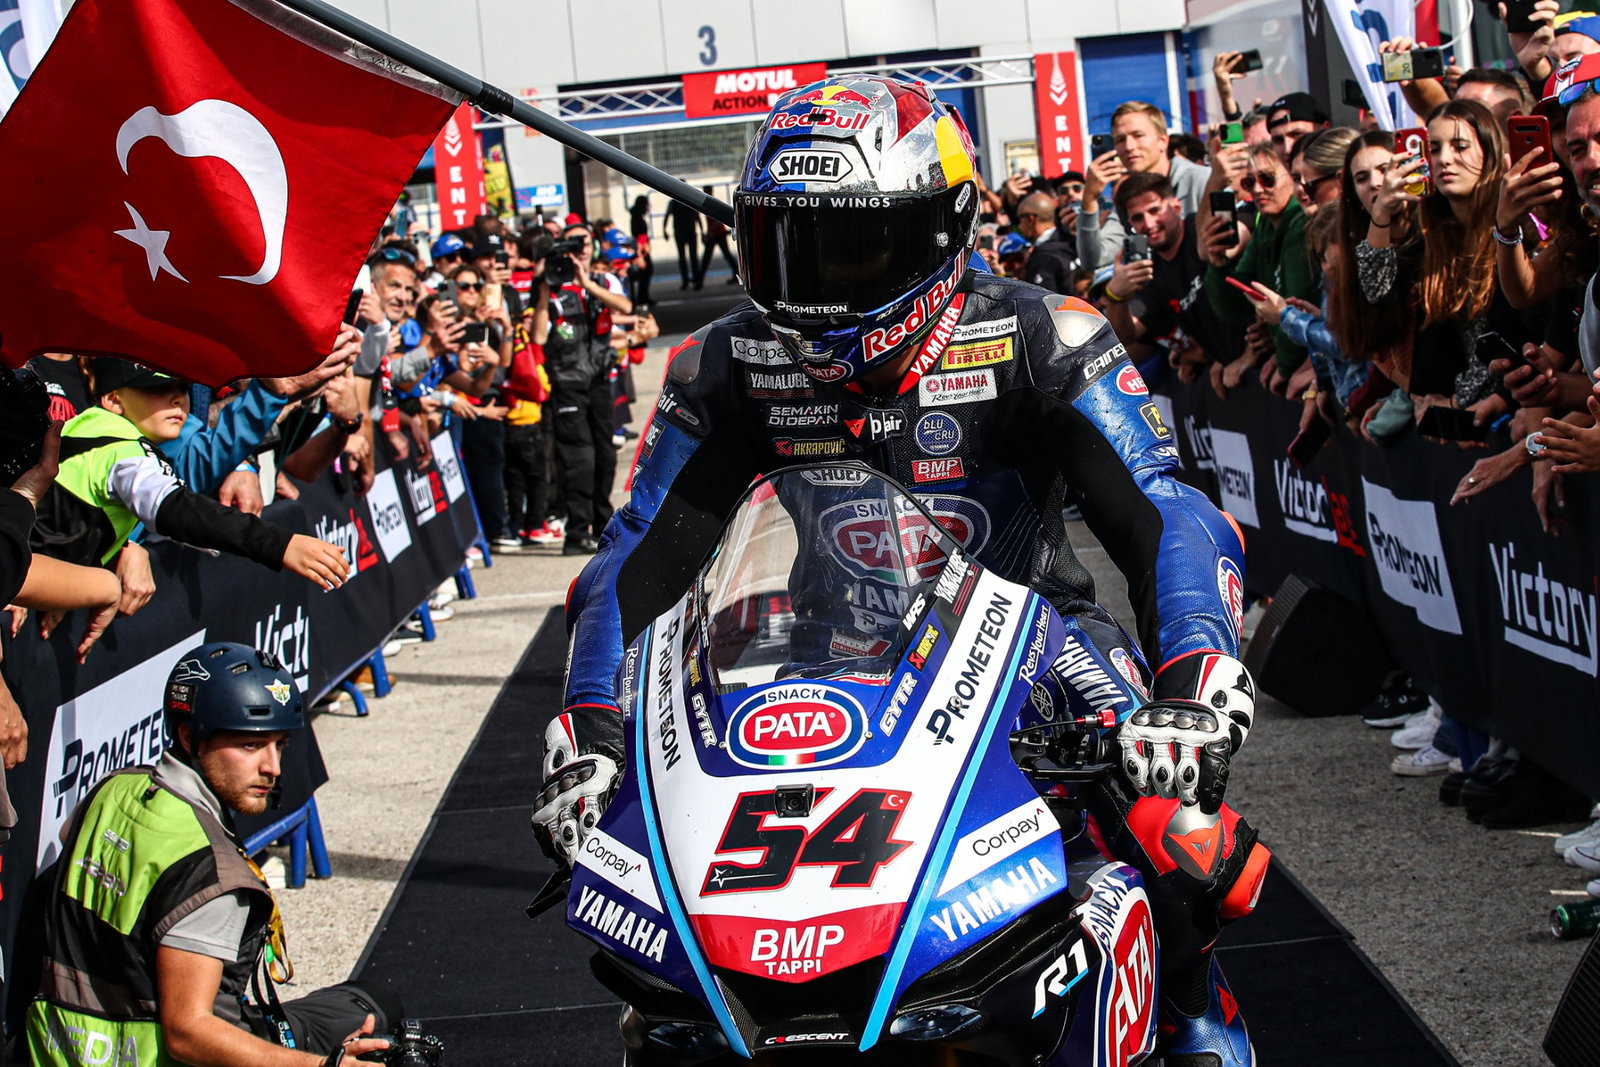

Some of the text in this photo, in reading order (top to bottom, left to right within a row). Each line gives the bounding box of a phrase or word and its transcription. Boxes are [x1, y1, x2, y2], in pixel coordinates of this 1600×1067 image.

[698, 25, 717, 66] 3
[714, 69, 797, 94] MOTUL
[713, 95, 768, 111] ACTION
[770, 108, 871, 130] Red Bull
[778, 155, 841, 177] SHOEI
[745, 195, 891, 208] GIVES YOU WINGS
[774, 301, 848, 314] PROMETEON
[862, 297, 927, 362] Red
[926, 247, 965, 319] Bull
[910, 306, 961, 376] YAMAHA
[953, 321, 1015, 338] PROMETEON
[734, 340, 787, 360] Corpa
[947, 342, 1006, 365] PIRELLI
[750, 372, 810, 390] YAMALUBE
[806, 365, 841, 379] PATA
[940, 374, 989, 392] YAMAHA
[785, 415, 838, 426] DEPAN
[918, 459, 958, 475] BMP
[856, 497, 935, 518] SNACK
[848, 525, 943, 560] PATA
[902, 592, 927, 631] WRS
[925, 592, 1013, 746] PROMETEON
[658, 615, 682, 772] PROMETEON
[767, 688, 823, 703] SNACK
[879, 672, 918, 738] GYTR
[691, 692, 718, 749] GYTR
[754, 711, 834, 742] PATA
[53, 709, 173, 819] PROMETE
[699, 786, 917, 898] 54
[972, 812, 1041, 857] Corpay
[586, 837, 635, 878] Corpay
[929, 856, 1058, 943] YAMAHA
[1090, 876, 1128, 948] SNACK
[574, 885, 669, 964] YAMAHA
[750, 924, 845, 962] BMP
[764, 958, 822, 976] TAPPI
[1031, 937, 1089, 1019] R1
[1115, 923, 1152, 1067] PATA
